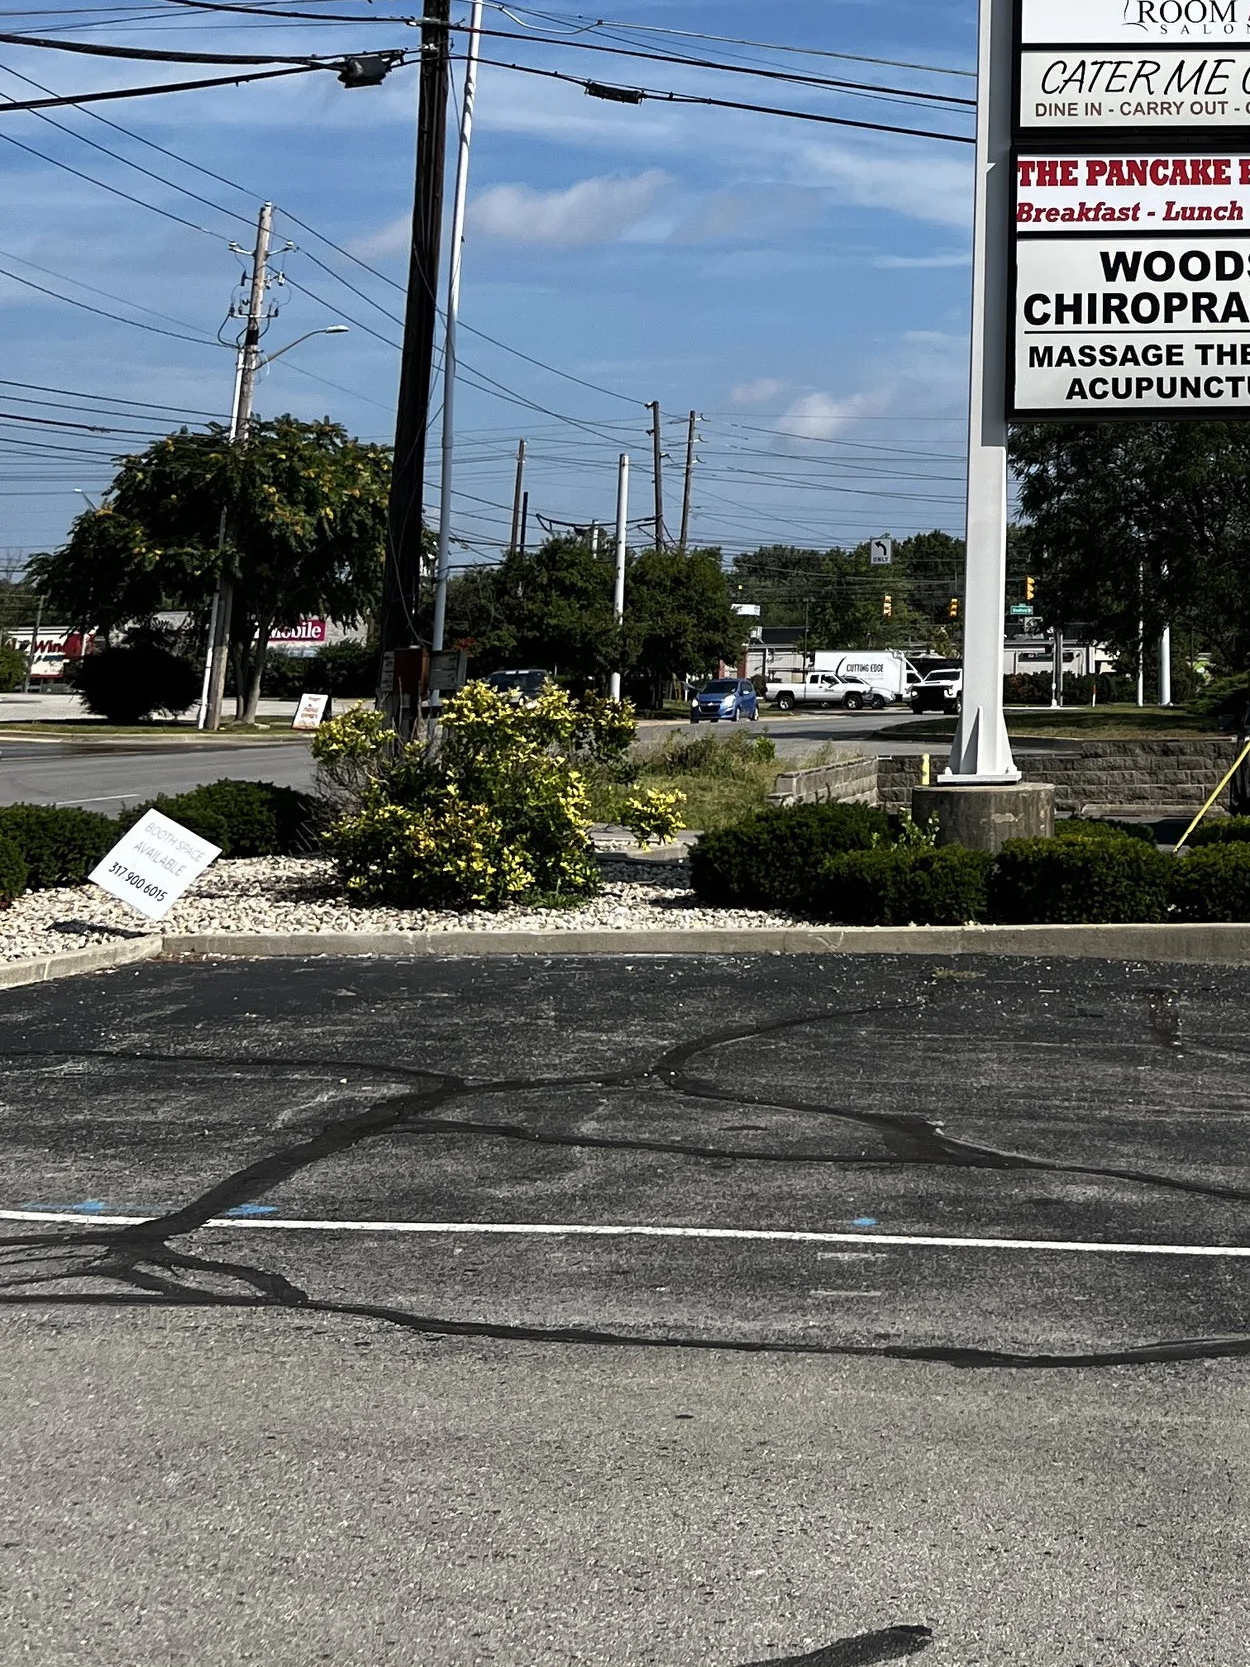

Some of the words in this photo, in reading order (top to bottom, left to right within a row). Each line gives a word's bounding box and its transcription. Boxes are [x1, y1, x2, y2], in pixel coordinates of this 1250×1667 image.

[1041, 59, 1161, 95] CATER
[1163, 59, 1236, 95] ME
[1035, 102, 1079, 117] DINE
[1084, 102, 1102, 116] IN
[1120, 101, 1184, 116] CARRY
[1189, 101, 1229, 116] OUT
[1017, 160, 1078, 187] THE
[1086, 159, 1231, 186] PANCAKE
[1016, 202, 1141, 223] Breakfast
[1163, 200, 1244, 222] Lunch
[1029, 344, 1184, 368] MASSAGE
[145, 822, 178, 847] BOOTH
[175, 840, 206, 863] SPACE
[133, 841, 188, 877] AVAILABLE
